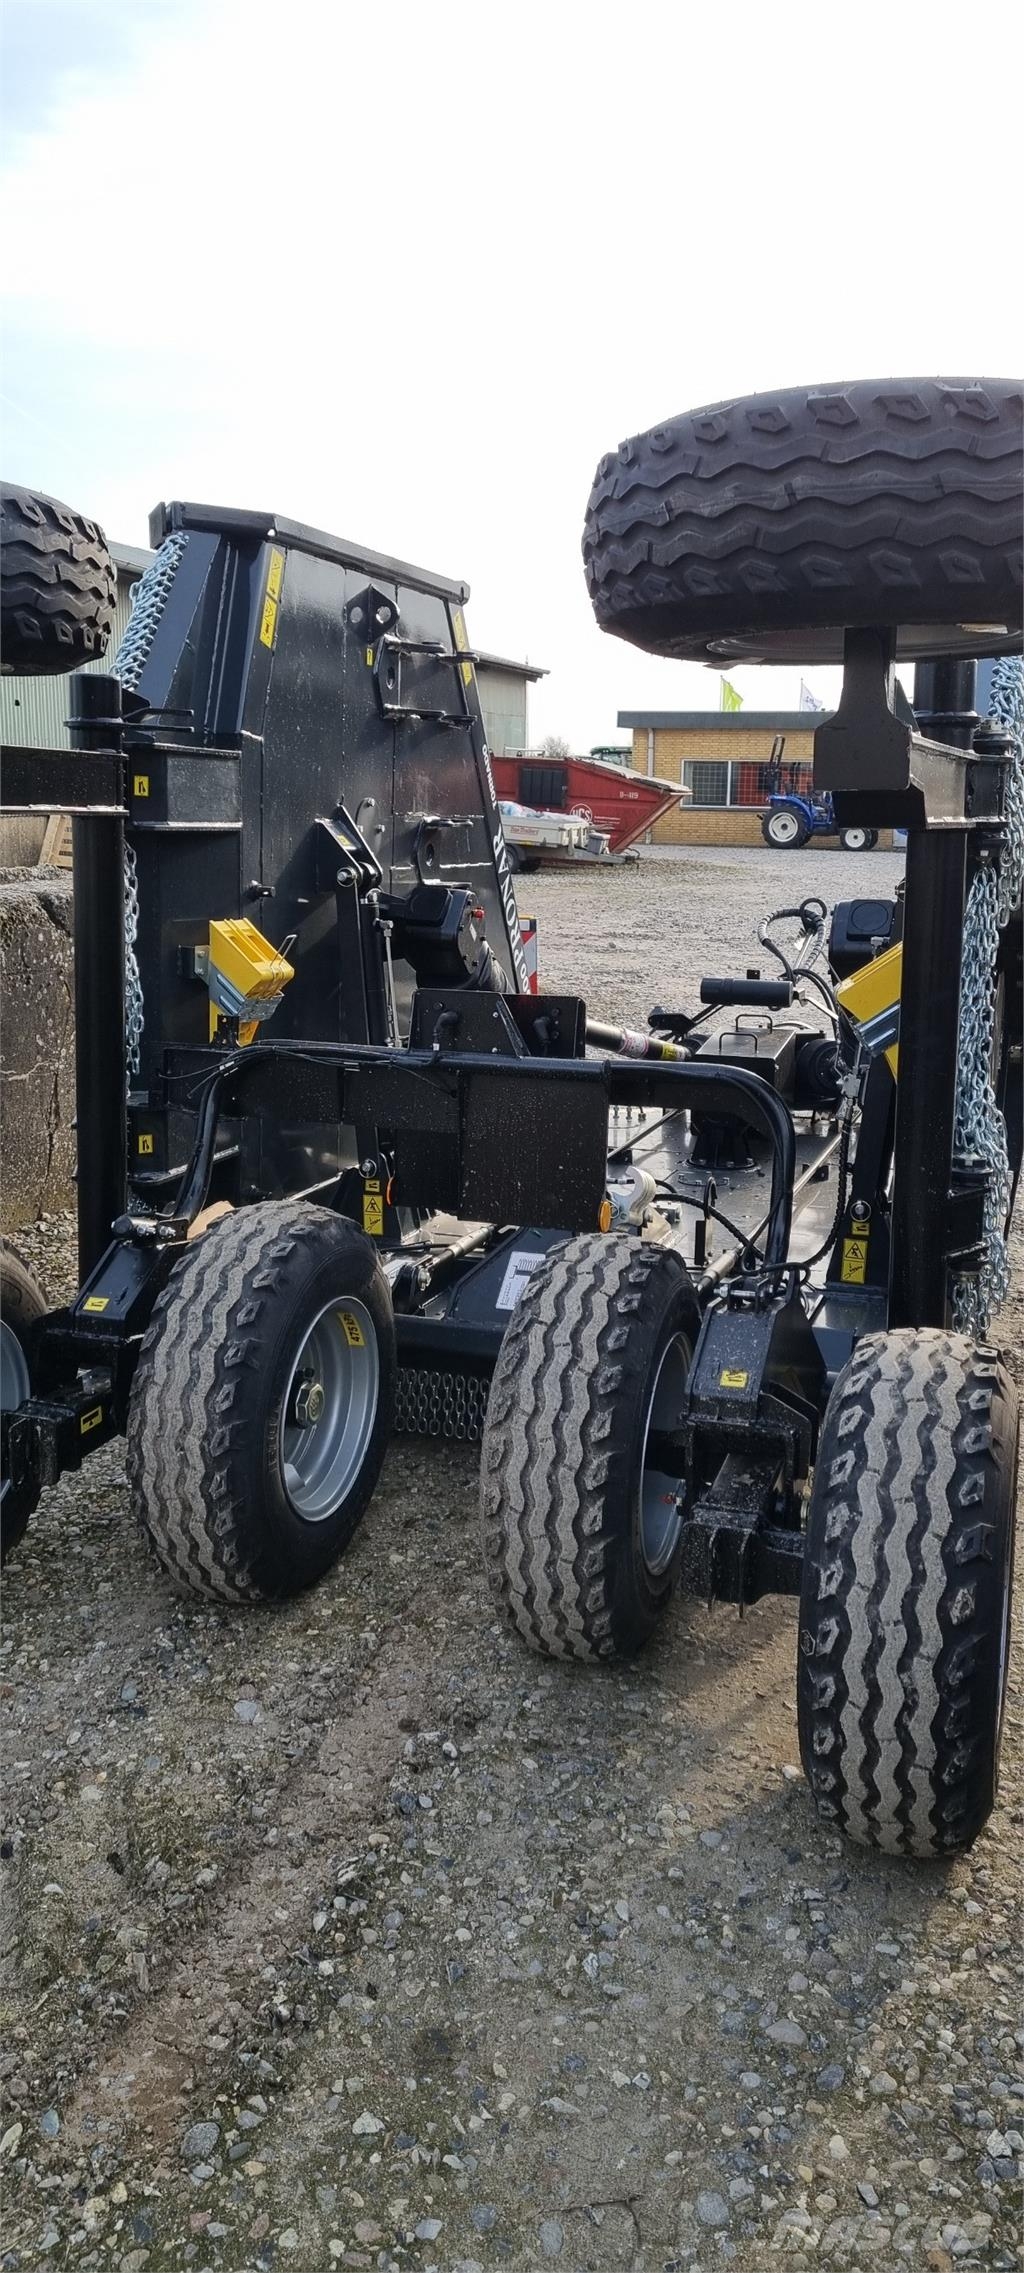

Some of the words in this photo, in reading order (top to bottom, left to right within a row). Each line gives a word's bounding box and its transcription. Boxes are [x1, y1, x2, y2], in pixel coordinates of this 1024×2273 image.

[482, 744, 497, 810] TORNADO
[493, 822, 523, 968] PRONAR
[347, 1327, 360, 1342] 475
